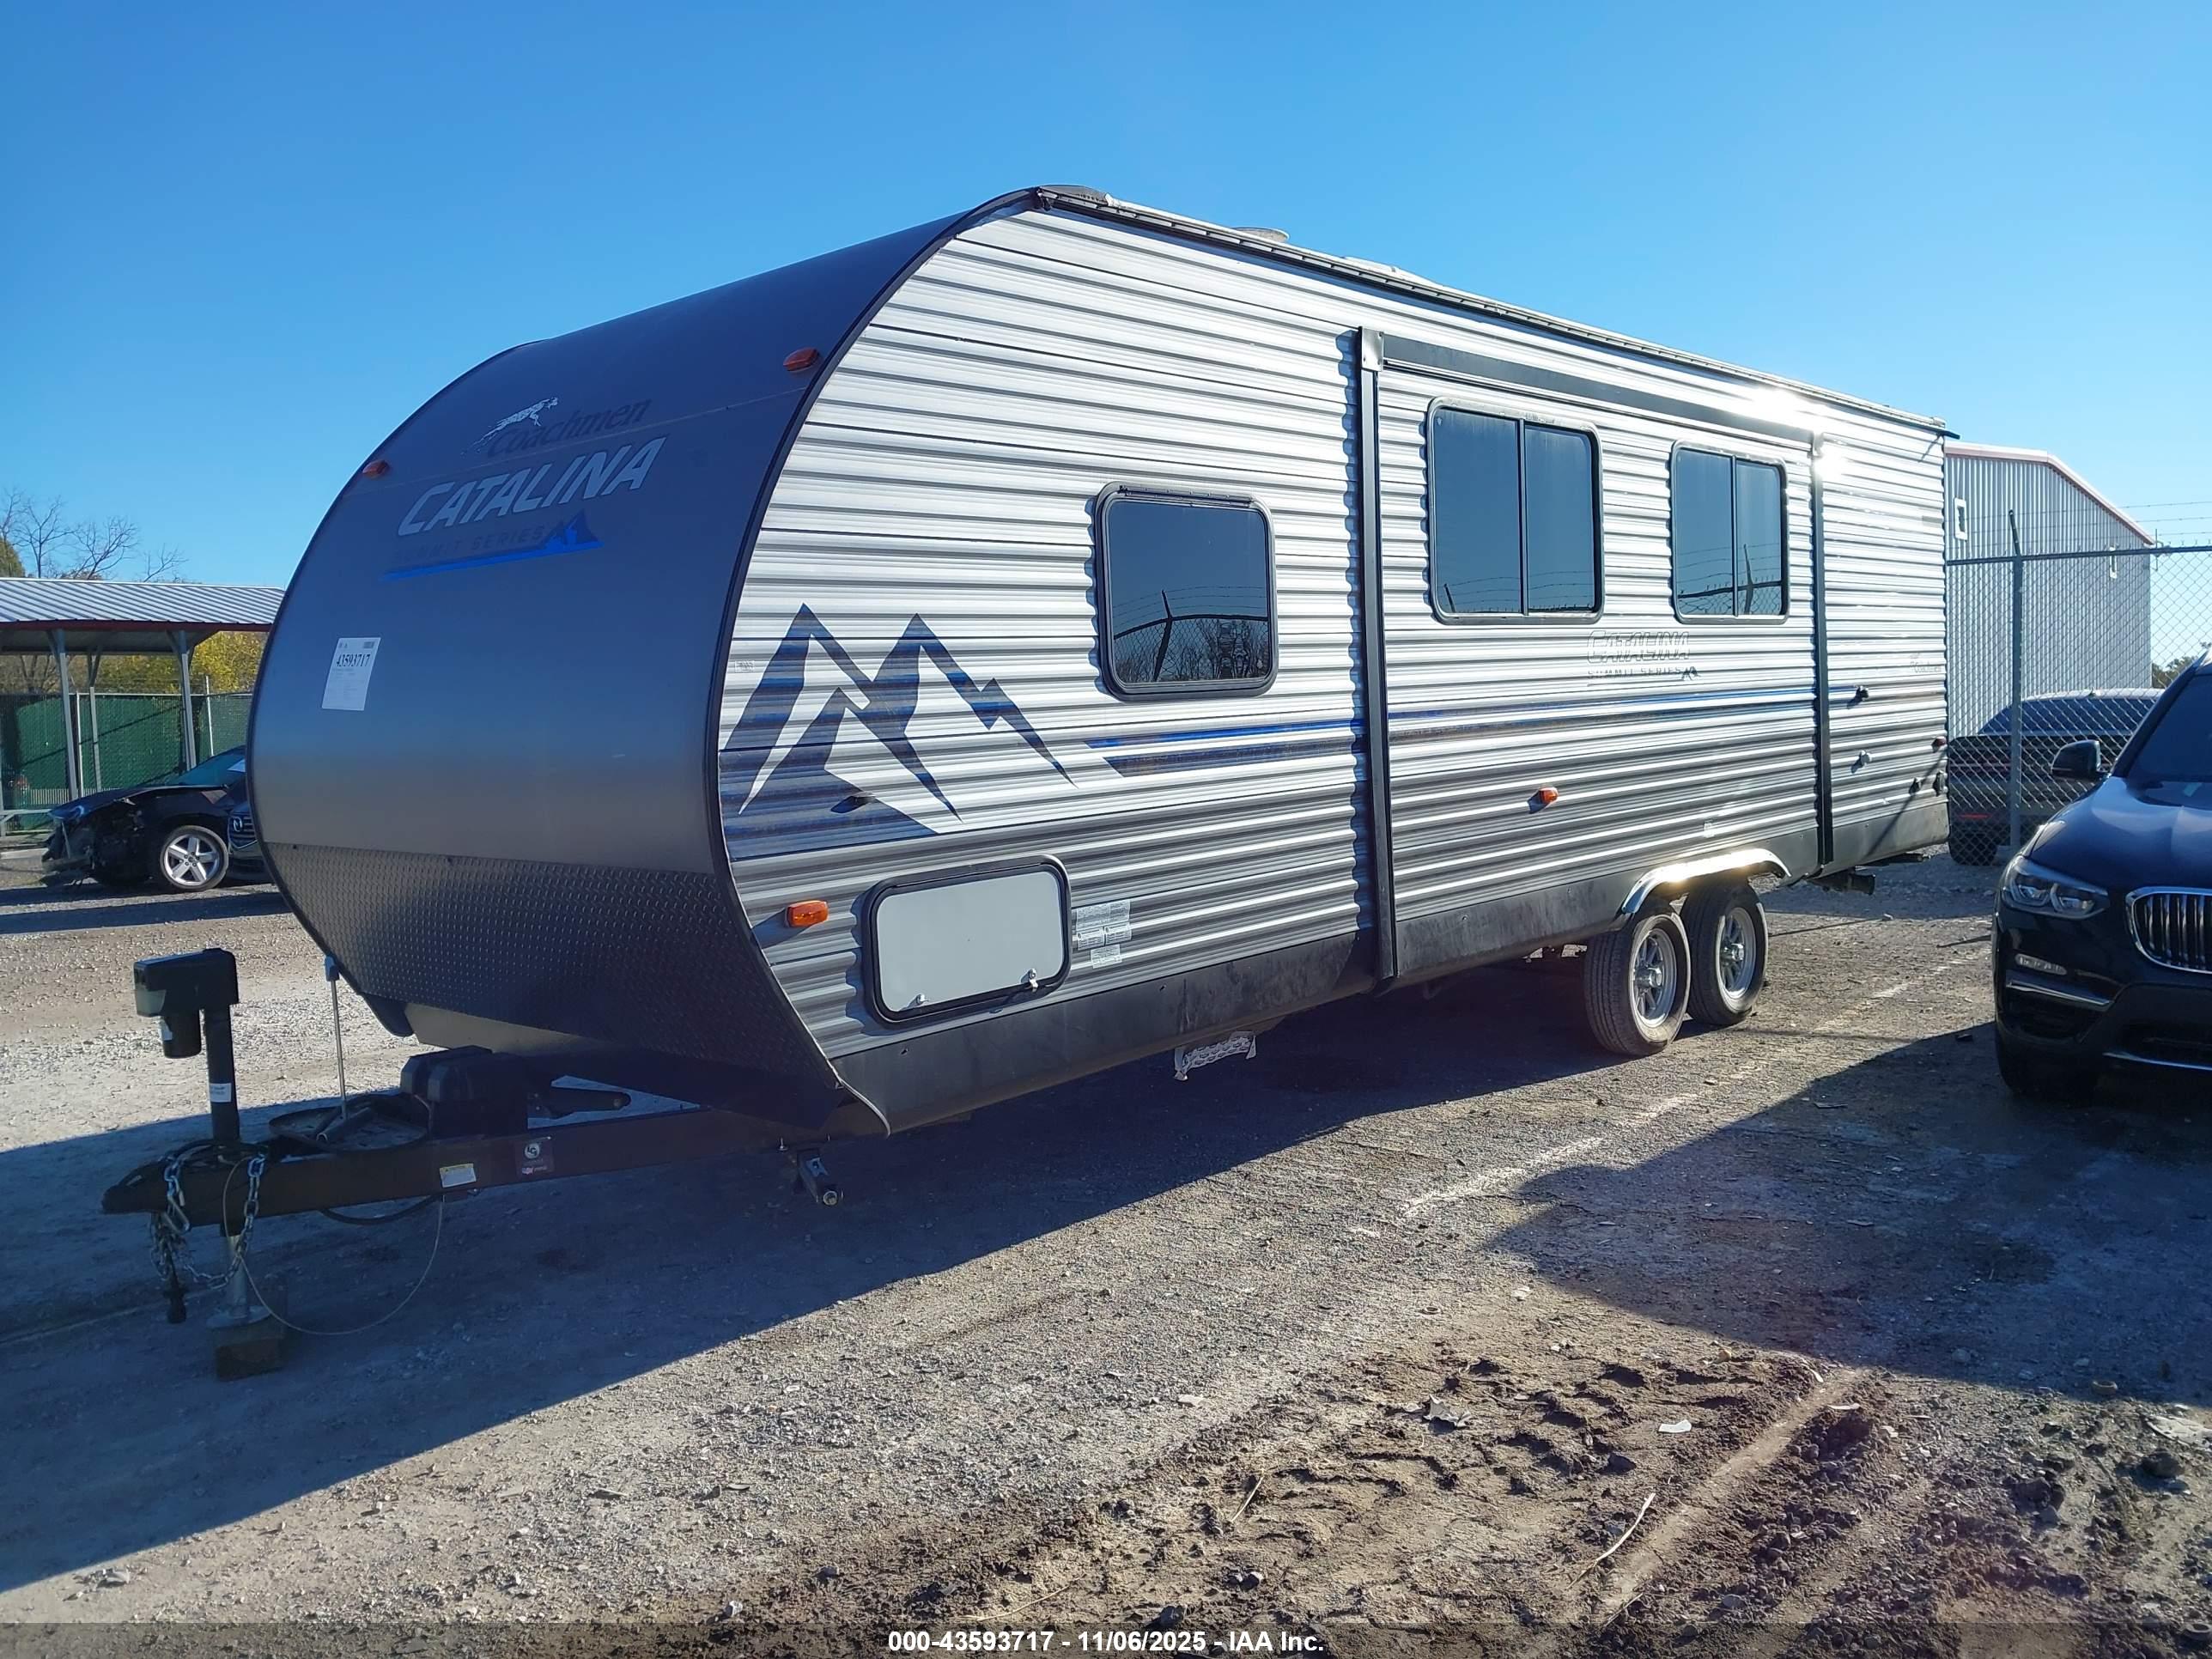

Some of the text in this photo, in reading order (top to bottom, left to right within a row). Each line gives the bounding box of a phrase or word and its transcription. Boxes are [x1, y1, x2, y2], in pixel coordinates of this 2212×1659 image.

[488, 399, 653, 458] Coachmen
[398, 436, 667, 536] CATALINA
[471, 526, 544, 550] SERIES
[336, 653, 371, 667] 43593717
[1587, 630, 1690, 663] CATALINA
